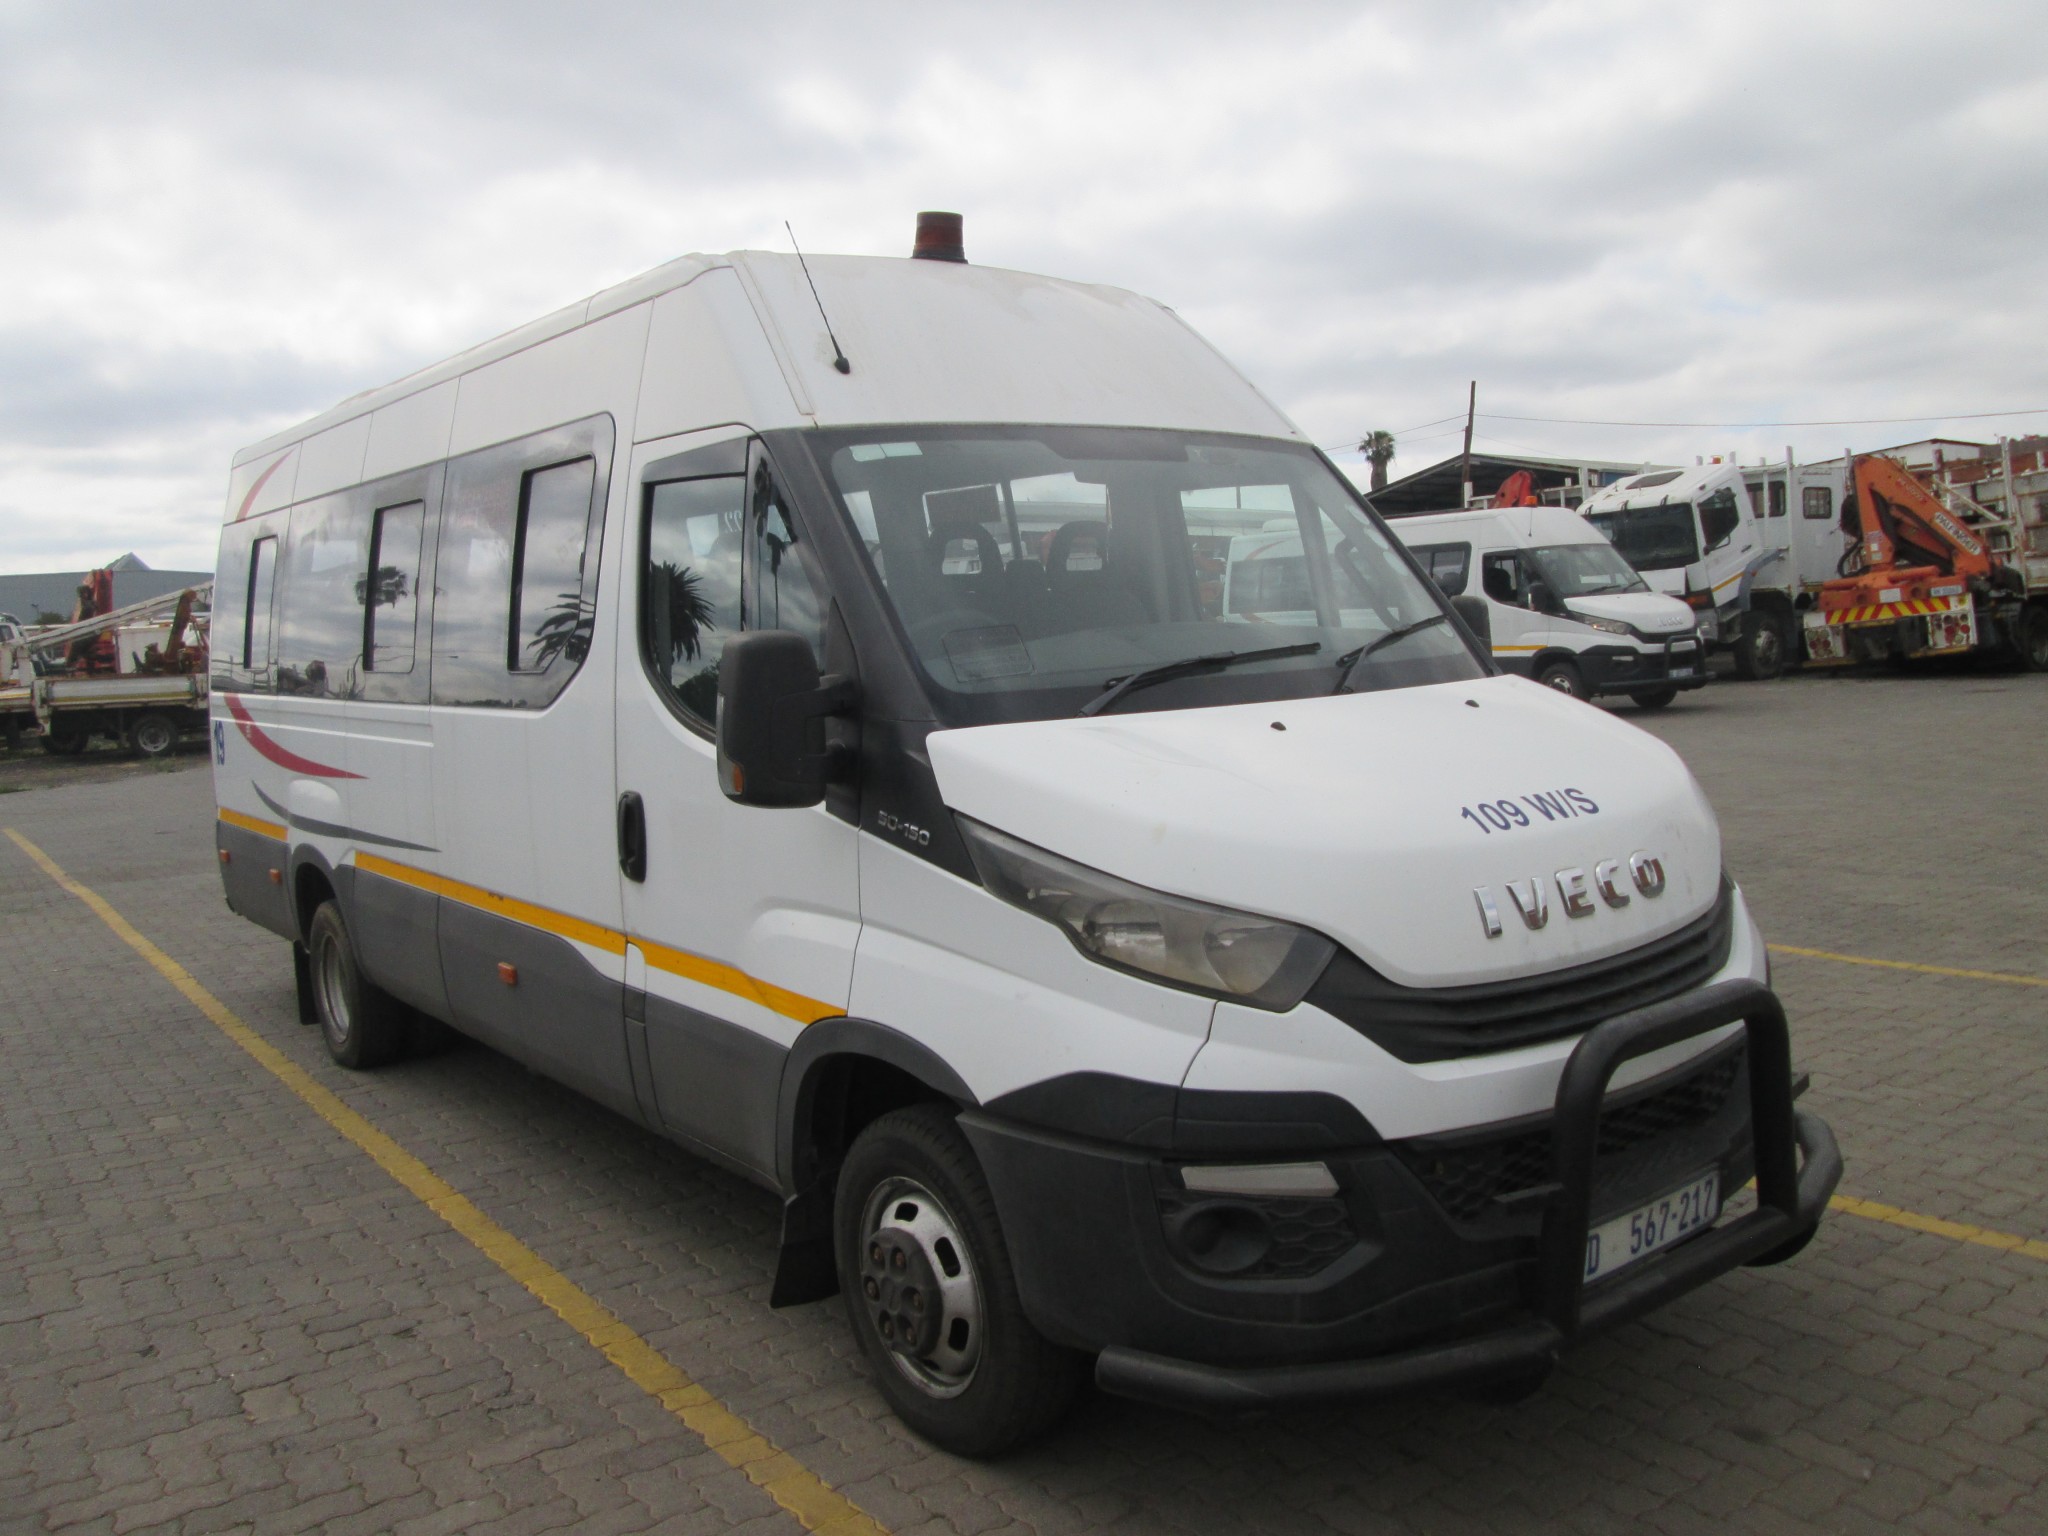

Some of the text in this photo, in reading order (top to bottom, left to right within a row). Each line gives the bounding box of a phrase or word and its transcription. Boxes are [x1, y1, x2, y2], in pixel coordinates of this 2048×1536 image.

[877, 810, 930, 846] 50-150
[1461, 787, 1599, 834] 109 W/S
[1473, 849, 1666, 939] IVECO
[1630, 1178, 1713, 1254] 567-217
